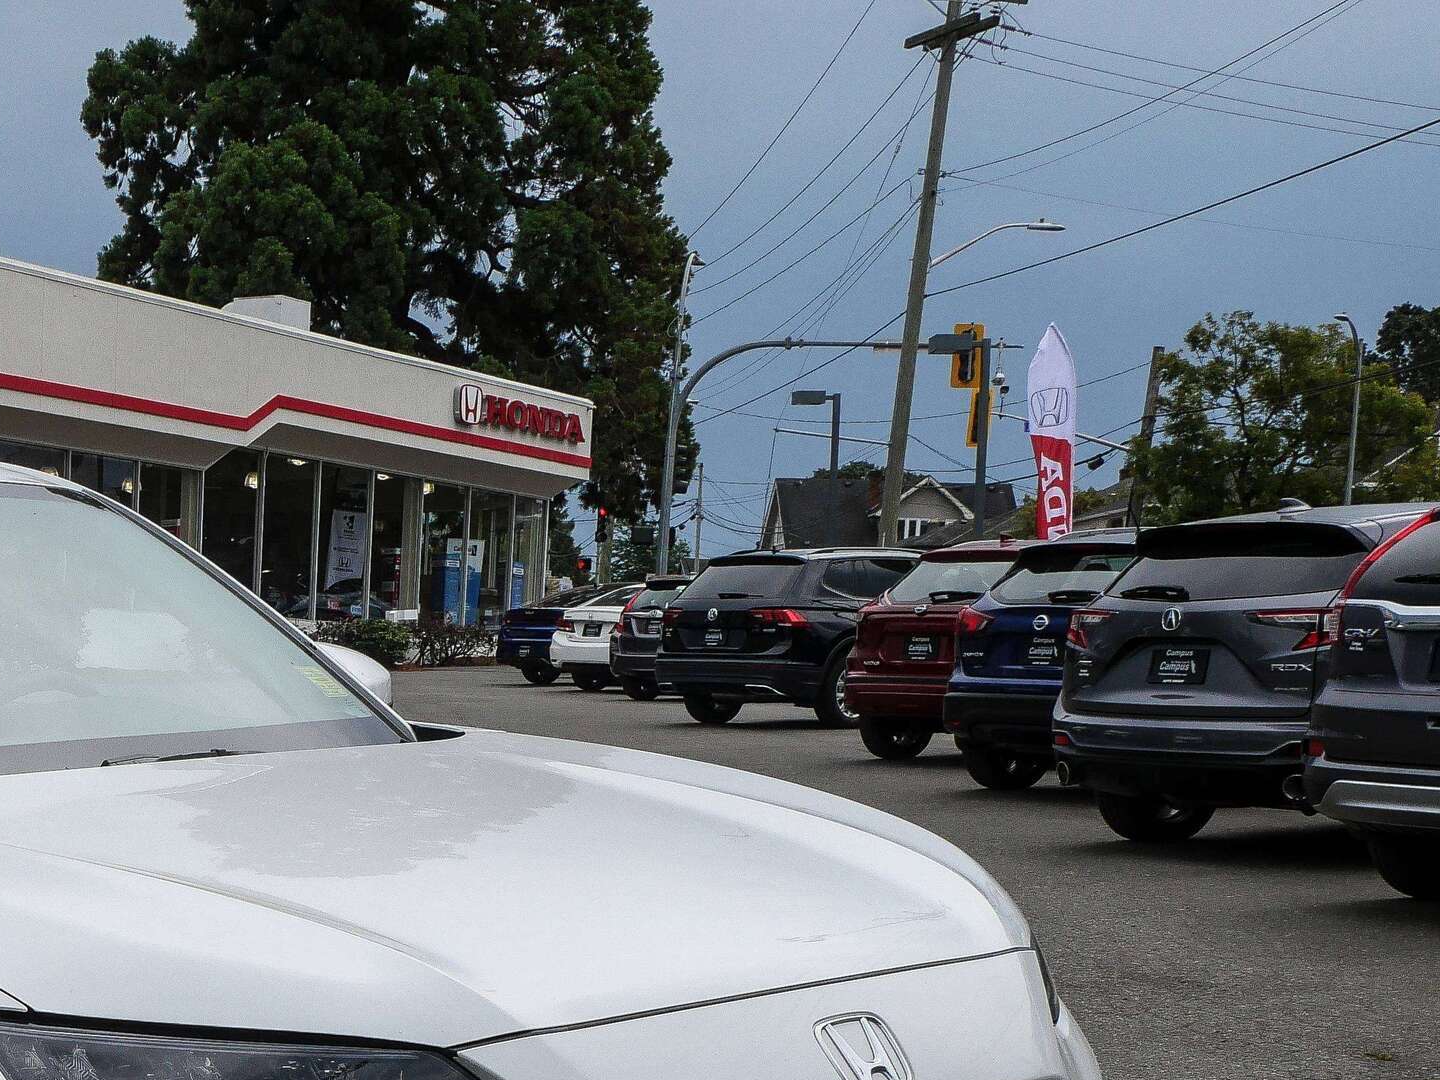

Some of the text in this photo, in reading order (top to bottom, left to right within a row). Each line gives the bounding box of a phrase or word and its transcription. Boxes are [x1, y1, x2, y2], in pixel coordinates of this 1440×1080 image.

[486, 394, 586, 444] HONDA
[1166, 649, 1194, 658] Campus
[1159, 661, 1190, 672] Campus
[1271, 663, 1313, 672] RDX
